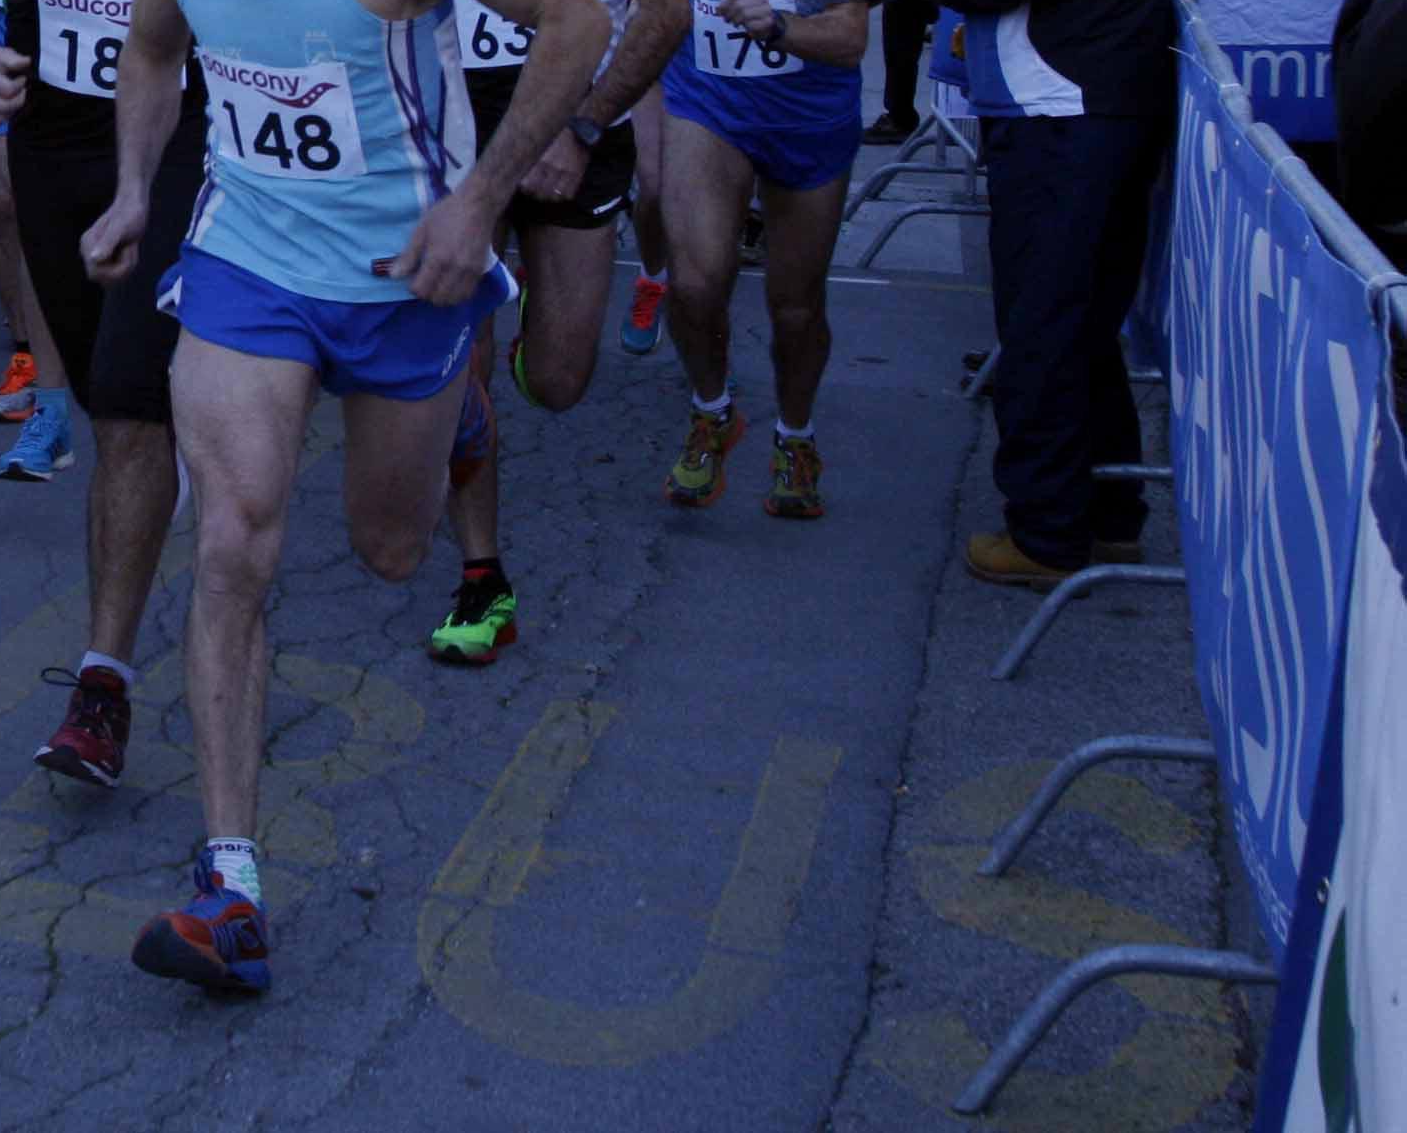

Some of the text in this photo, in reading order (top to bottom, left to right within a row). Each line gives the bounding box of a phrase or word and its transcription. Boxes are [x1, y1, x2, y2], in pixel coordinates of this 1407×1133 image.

[59, 28, 124, 91] 18
[202, 53, 301, 97] saucony
[222, 98, 341, 172] 148
